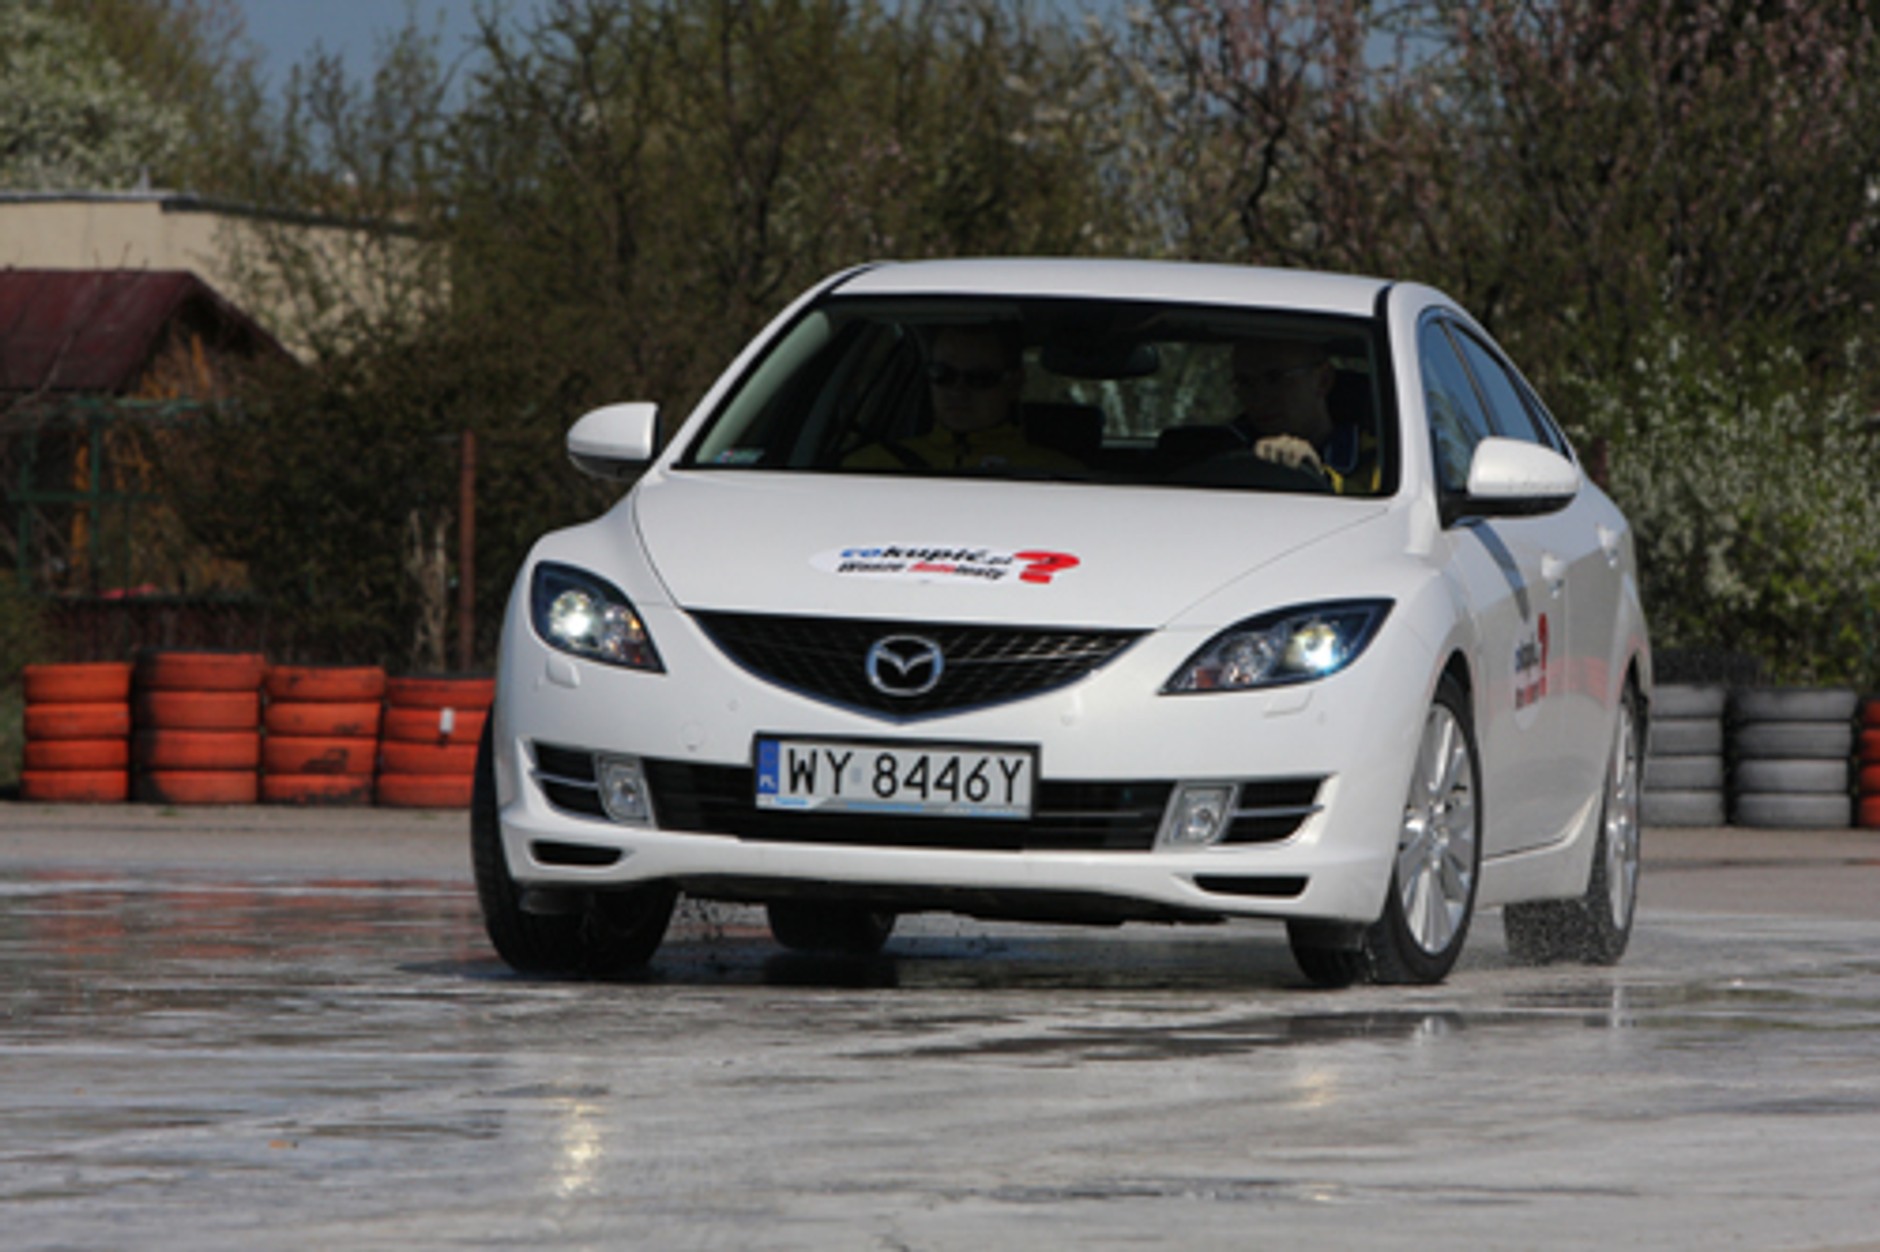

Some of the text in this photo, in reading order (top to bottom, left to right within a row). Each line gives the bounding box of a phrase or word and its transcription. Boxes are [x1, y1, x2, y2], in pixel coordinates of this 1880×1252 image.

[759, 774, 776, 789] PL
[787, 748, 1023, 804] WY 8446Y
